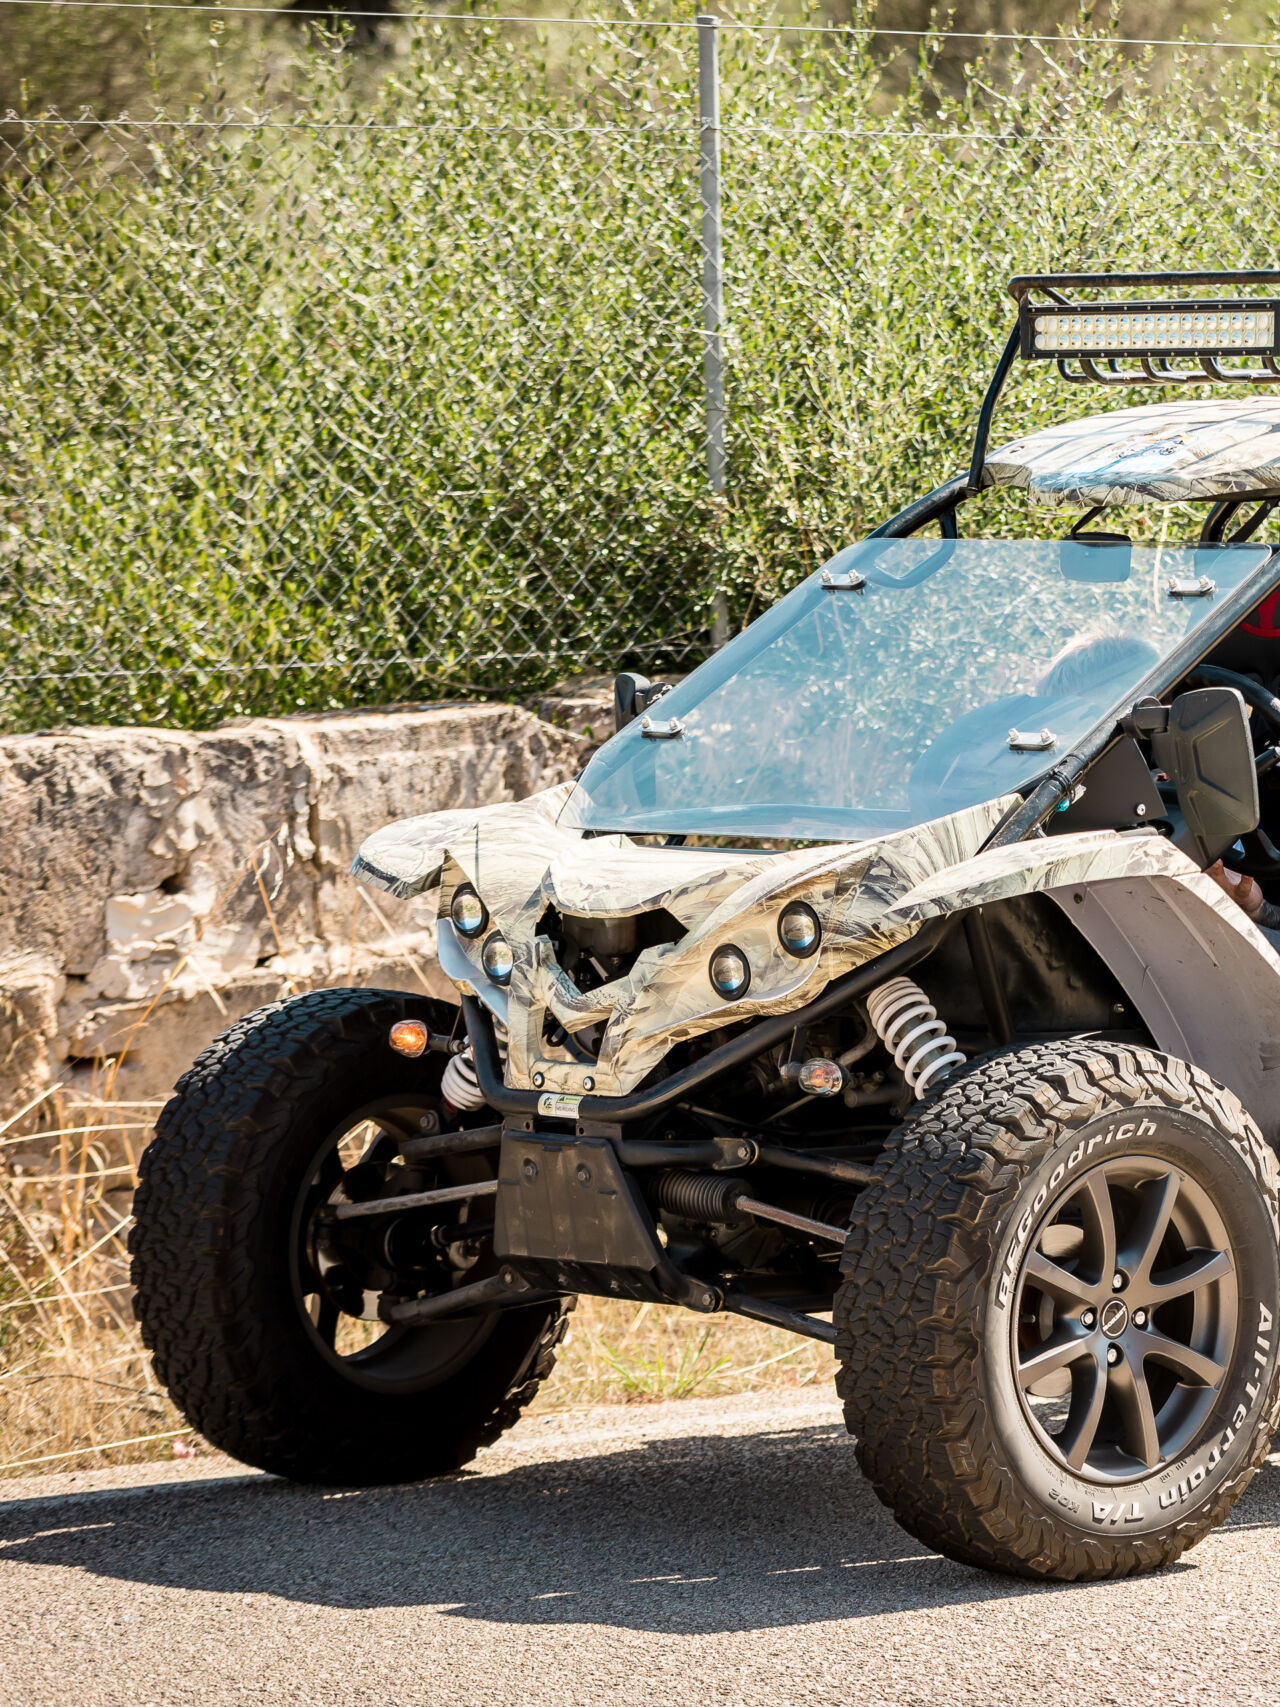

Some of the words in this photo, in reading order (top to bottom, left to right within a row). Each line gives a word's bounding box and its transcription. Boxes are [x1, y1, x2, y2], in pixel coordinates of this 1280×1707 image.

[998, 1117, 1157, 1311] BFGoodrich
[1158, 1301, 1274, 1511] All-Terrain
[1048, 1488, 1082, 1514] KO2
[1091, 1500, 1145, 1526] T/A
